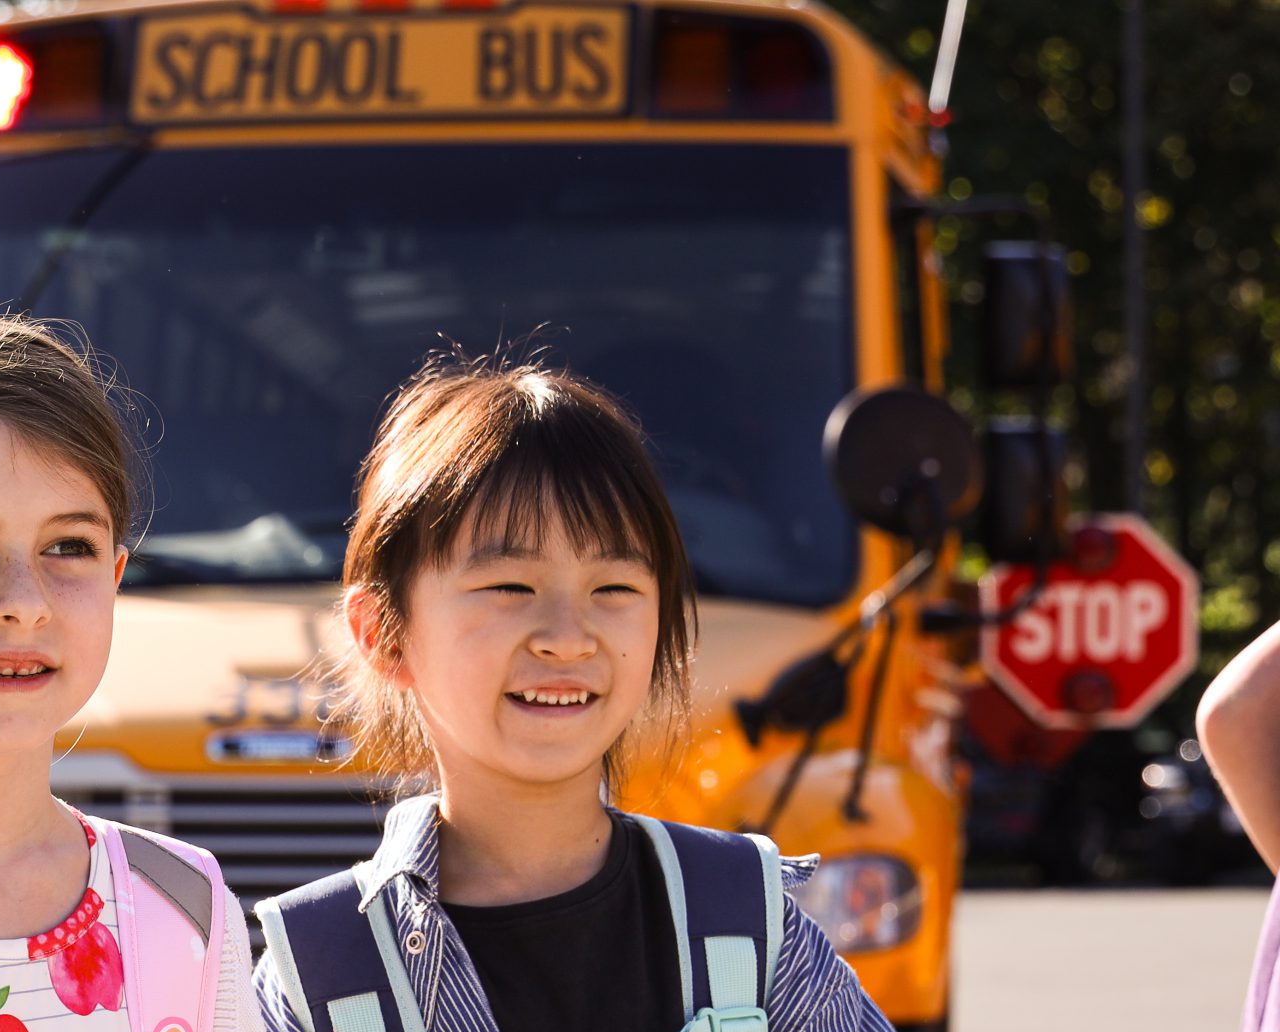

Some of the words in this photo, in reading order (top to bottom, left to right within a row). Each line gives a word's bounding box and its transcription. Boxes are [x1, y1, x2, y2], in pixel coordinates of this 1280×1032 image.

[145, 25, 420, 108] SCHOOL
[476, 20, 612, 101] BUS
[1009, 578, 1167, 664] STOP
